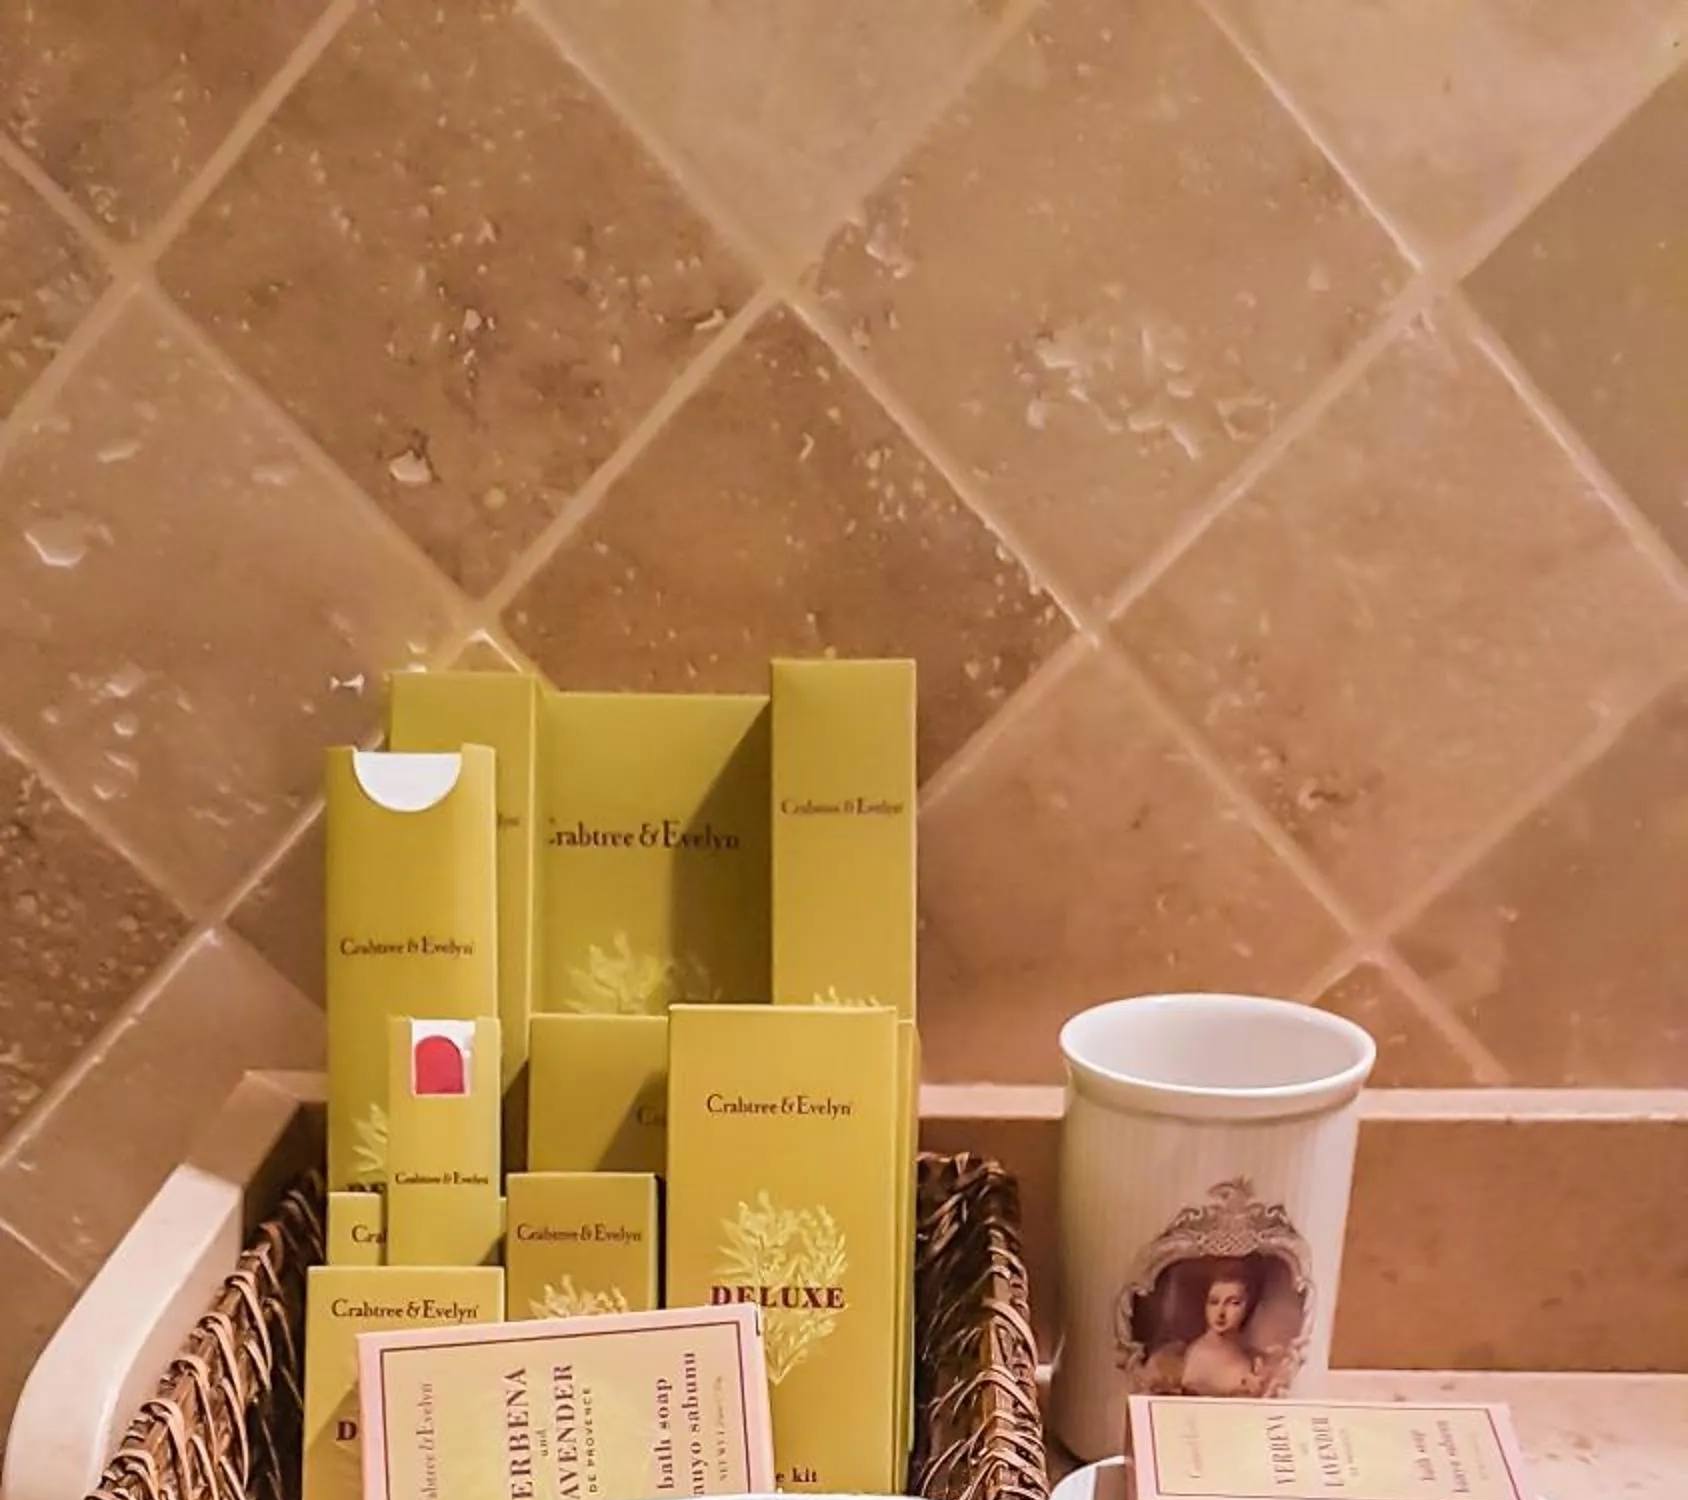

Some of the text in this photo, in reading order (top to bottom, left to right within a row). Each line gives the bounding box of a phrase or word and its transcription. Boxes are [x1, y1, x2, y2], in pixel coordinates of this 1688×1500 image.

[549, 818, 634, 847] rabtree
[639, 823, 661, 848] &
[663, 820, 740, 852] Evelyn
[706, 1093, 852, 1120] Crabtree & Evelyn
[331, 1298, 480, 1323] Crabtree & Evelyn
[711, 1286, 845, 1309] DELUXE
[583, 1388, 596, 1467] PROVENCE
[654, 1377, 675, 1489] bath soap
[690, 1441, 709, 1496] anyo
[791, 1467, 818, 1483] kit
